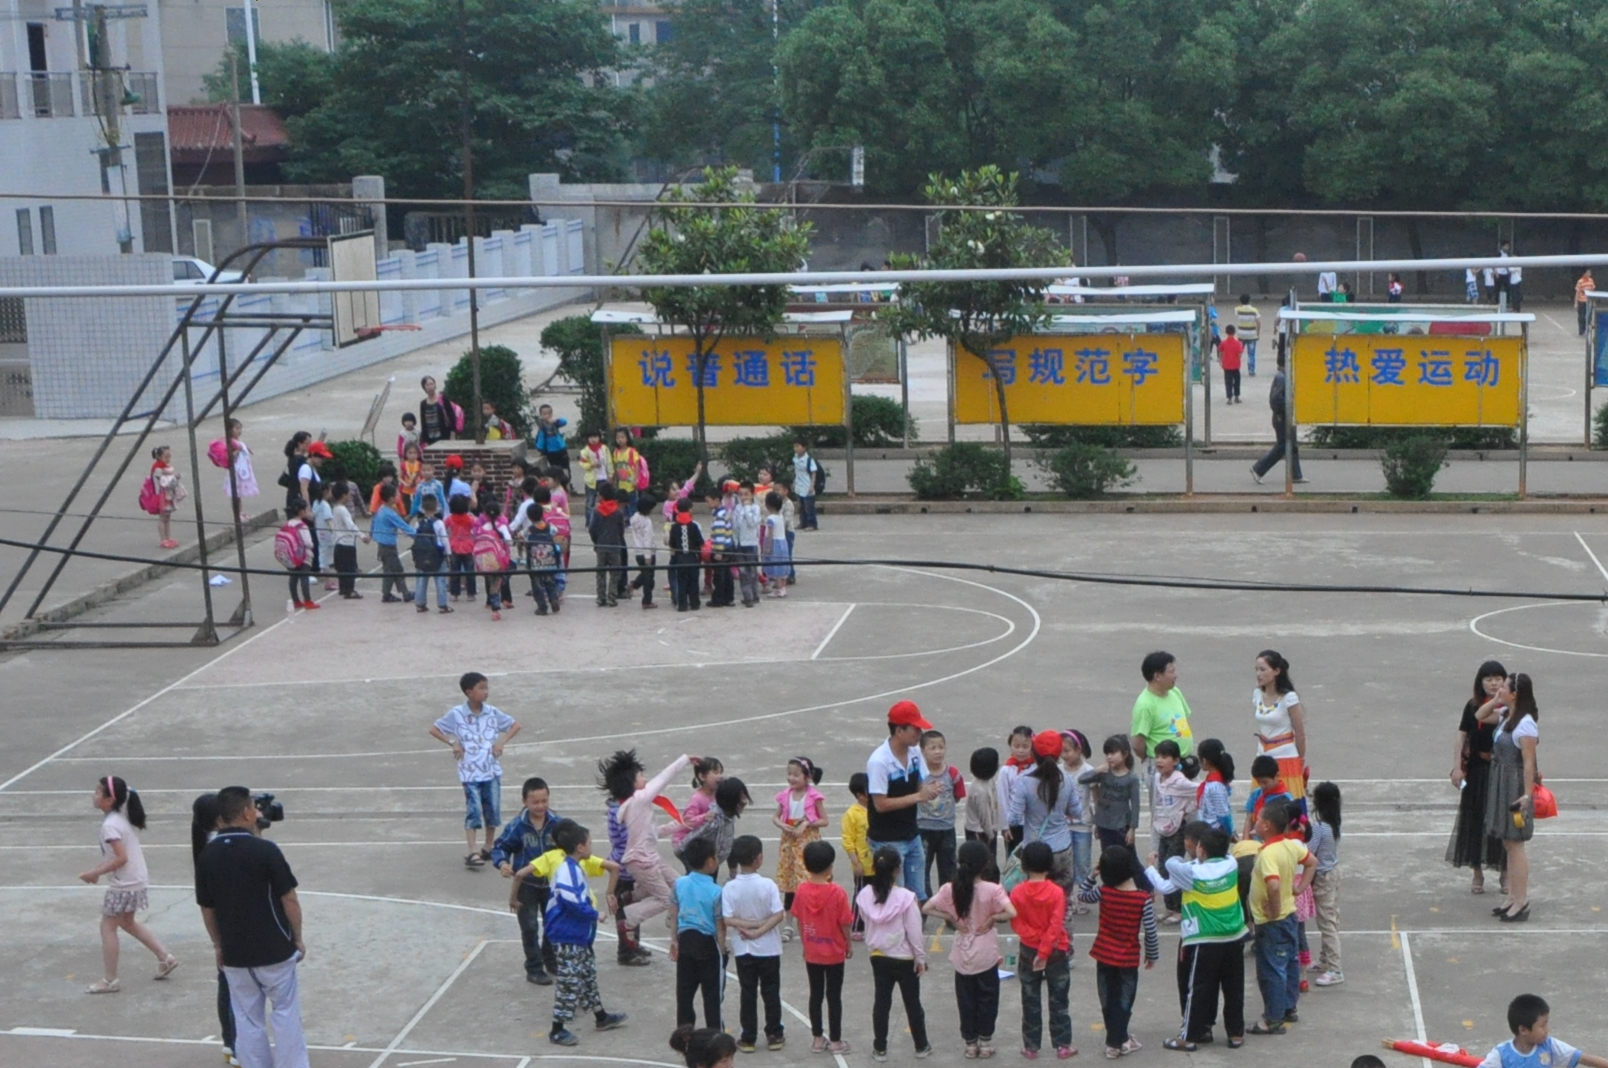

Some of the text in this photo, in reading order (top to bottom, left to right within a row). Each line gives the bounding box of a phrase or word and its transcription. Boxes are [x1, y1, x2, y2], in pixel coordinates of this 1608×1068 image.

[638, 350, 817, 388] 说普通话
[982, 347, 1160, 386] 写规范字
[1324, 347, 1500, 388] 热爱运动
